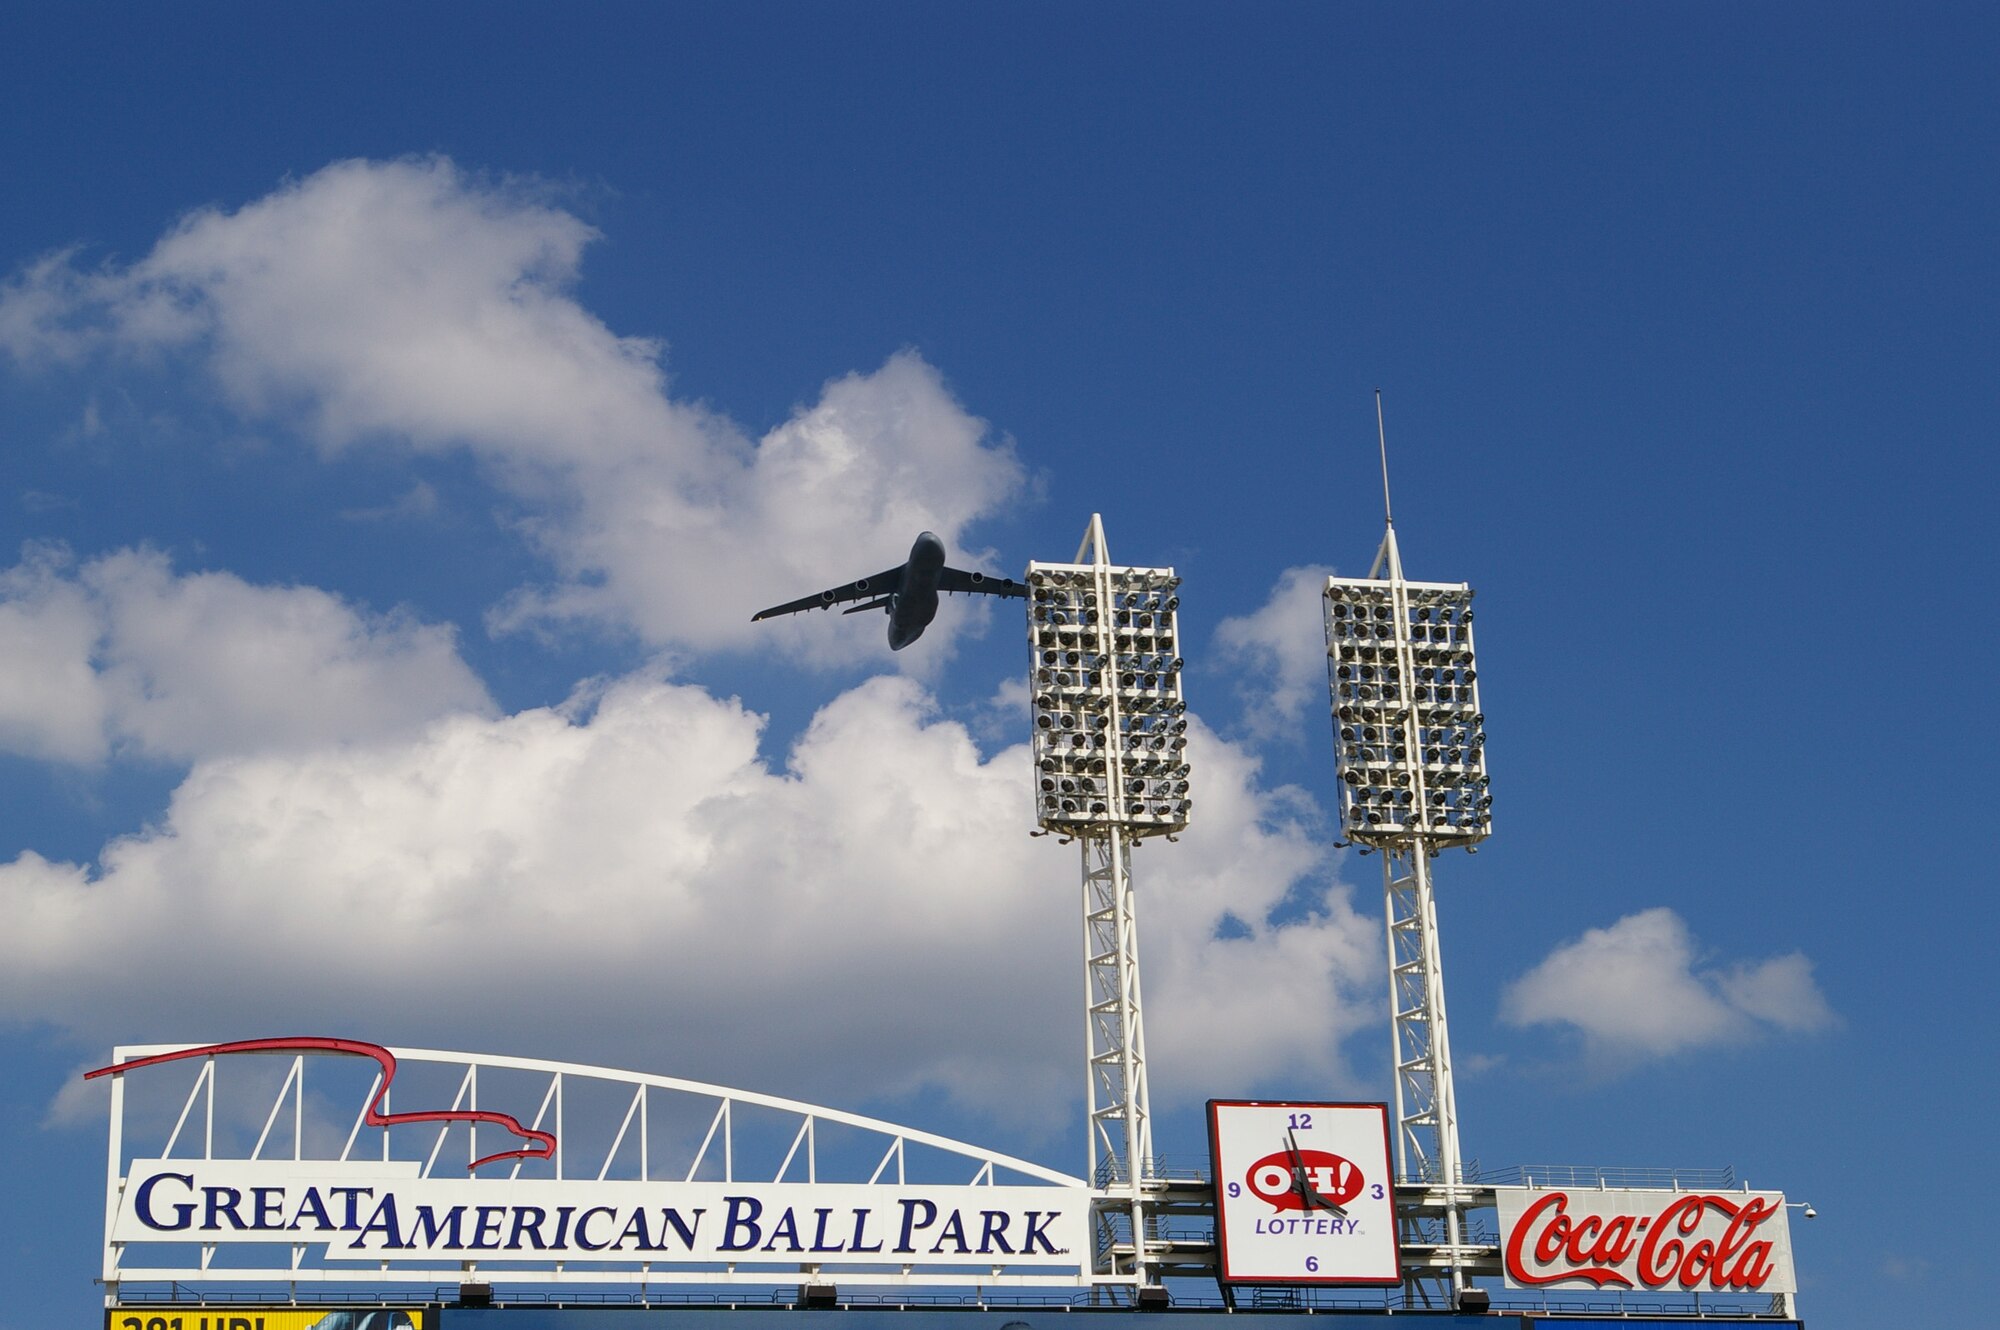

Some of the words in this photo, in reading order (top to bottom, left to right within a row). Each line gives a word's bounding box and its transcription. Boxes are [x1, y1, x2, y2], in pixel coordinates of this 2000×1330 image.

[1288, 1113, 1313, 1130] 12
[1253, 1161, 1352, 1196] OH!
[1228, 1182, 1241, 1199] 9
[1371, 1184, 1384, 1201] 3
[134, 1172, 374, 1231] GREAT
[348, 1192, 706, 1252] AMERICAN
[716, 1196, 884, 1253] BALL
[891, 1199, 1062, 1255] PARK
[1255, 1218, 1360, 1235] LOTTERY
[1506, 1192, 1784, 1288] Coca-Cola
[1305, 1256, 1319, 1272] 6
